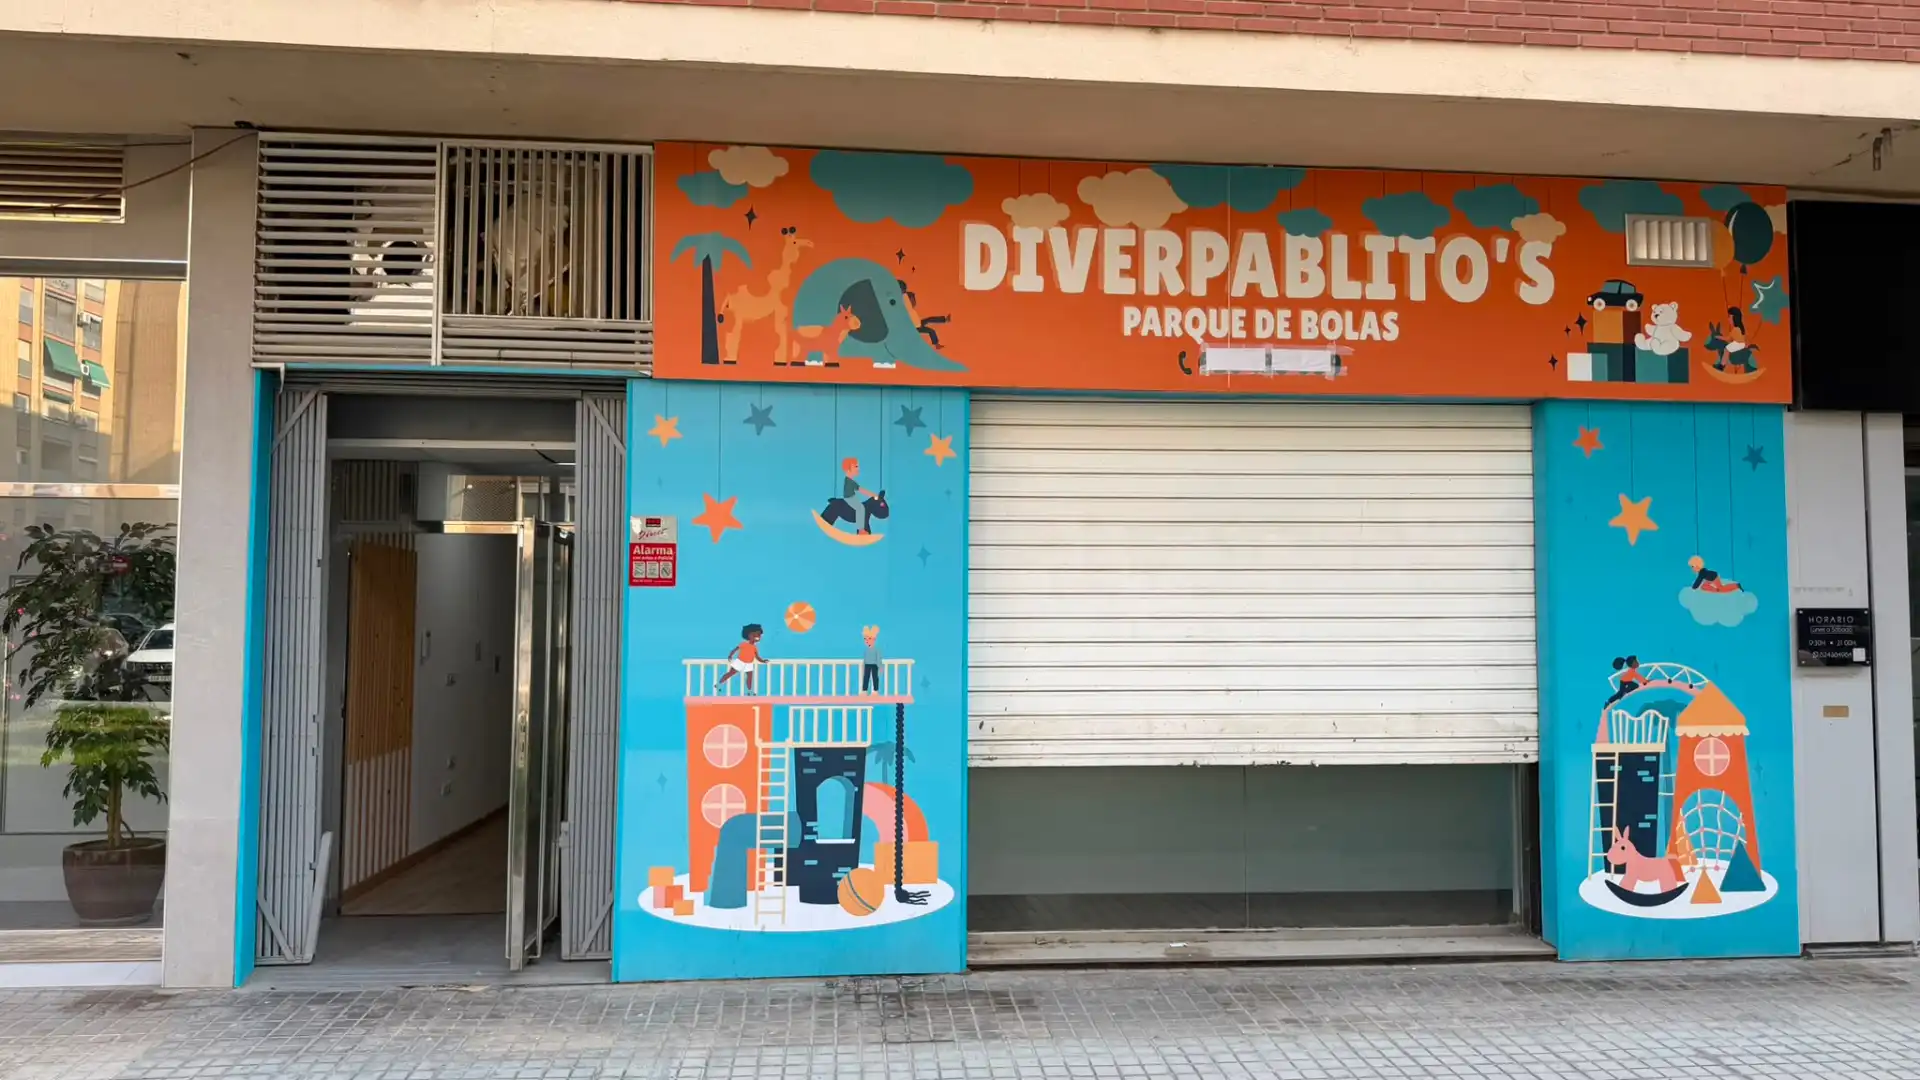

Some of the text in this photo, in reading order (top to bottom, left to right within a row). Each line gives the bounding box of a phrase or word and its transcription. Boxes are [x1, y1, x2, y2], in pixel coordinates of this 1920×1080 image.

[963, 222, 1555, 305] DIVERPABLITO'S
[1122, 306, 1399, 345] PARQUE DE BOLAS
[633, 545, 673, 555] Alarma
[1808, 615, 1854, 624] HORARIO
